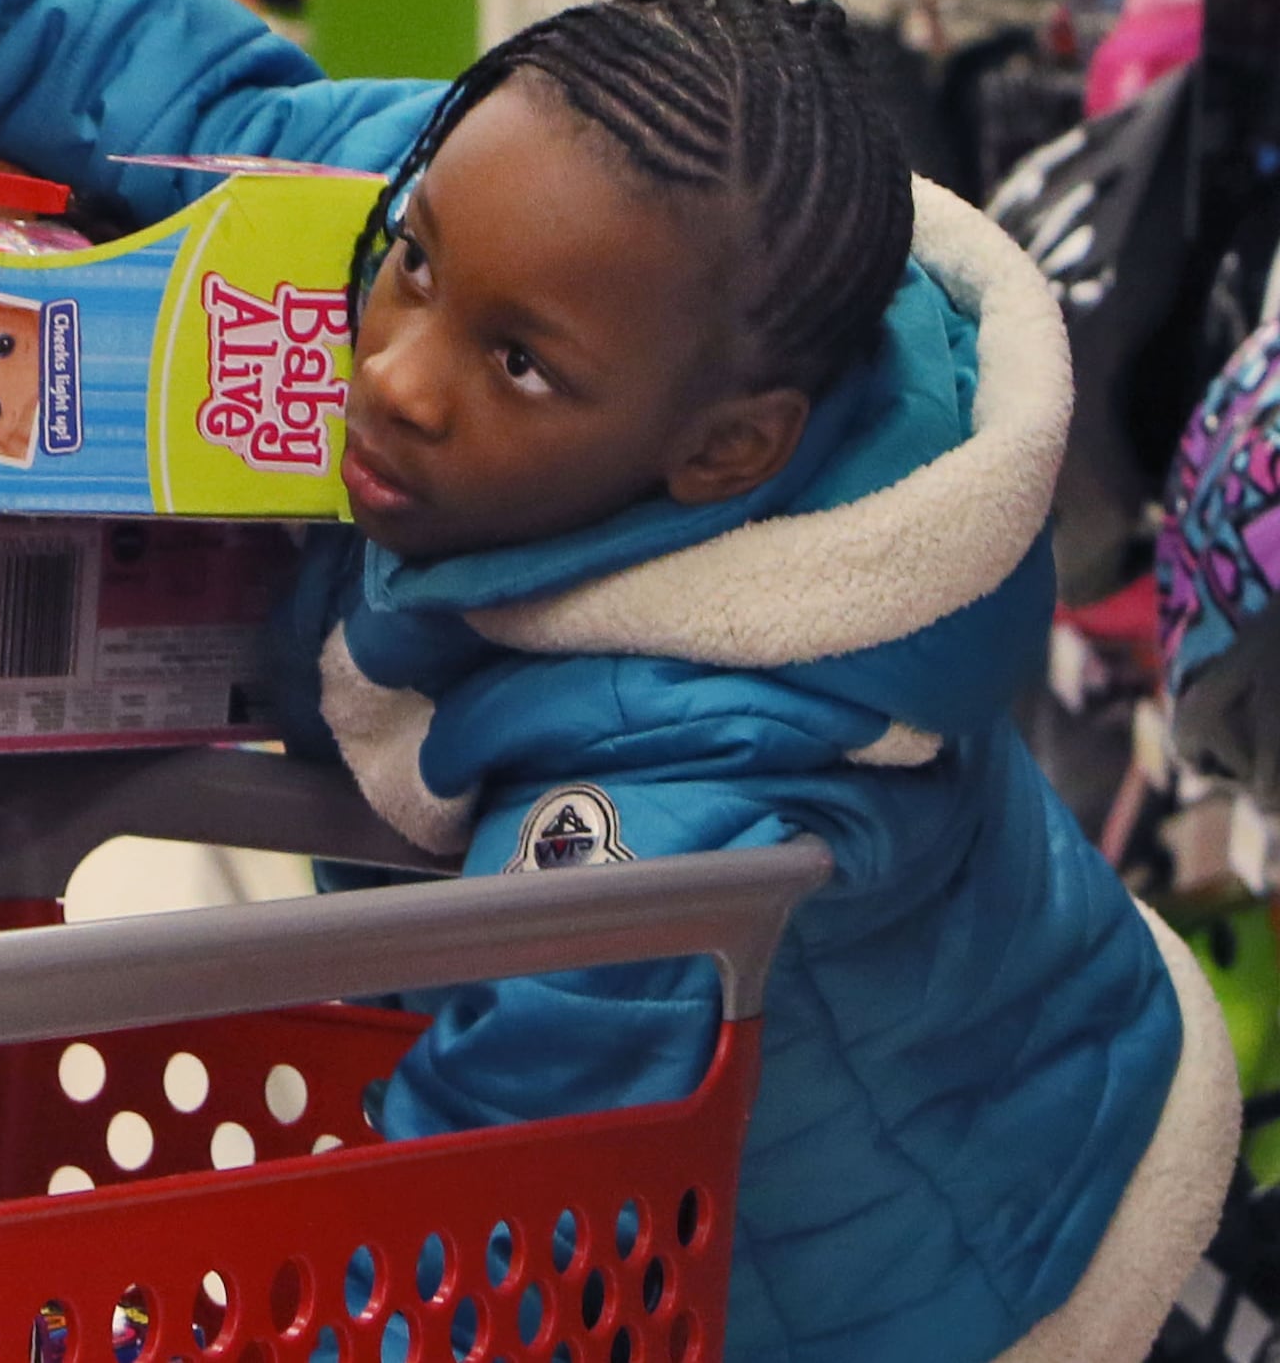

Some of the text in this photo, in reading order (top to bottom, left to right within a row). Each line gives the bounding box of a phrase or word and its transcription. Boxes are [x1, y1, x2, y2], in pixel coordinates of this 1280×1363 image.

[49, 312, 72, 441] Cheeks light up!
[205, 281, 281, 439] Alive
[249, 289, 350, 468] Baby
